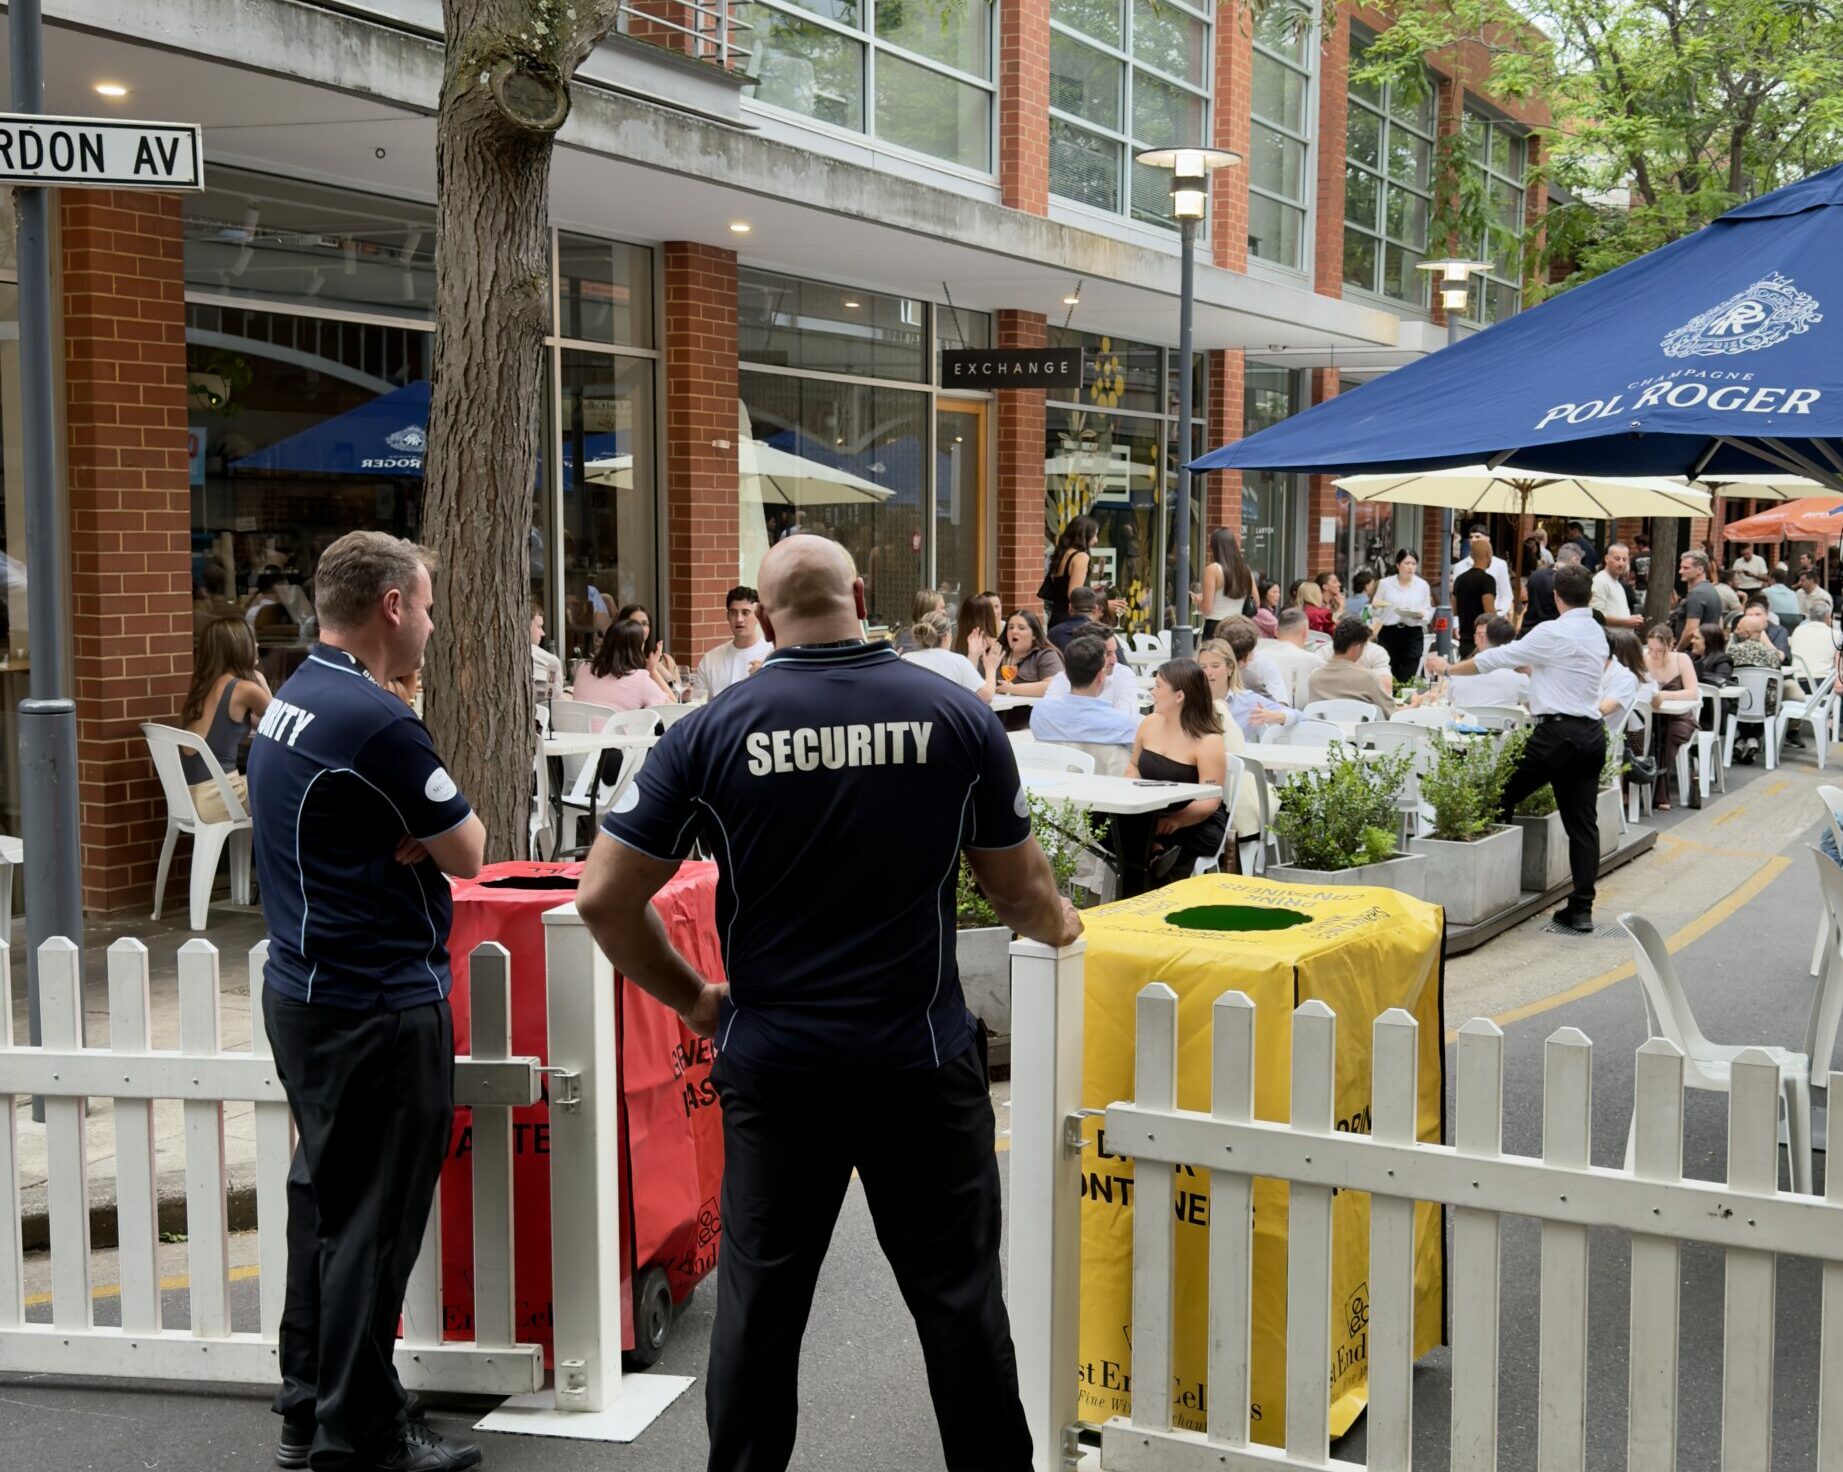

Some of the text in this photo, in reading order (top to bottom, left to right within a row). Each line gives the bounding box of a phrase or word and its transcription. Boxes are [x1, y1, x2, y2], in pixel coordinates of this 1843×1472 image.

[134, 136, 180, 176] AV
[954, 361, 1069, 375] EXCHANGE
[1627, 368, 1755, 390] CHAMPAGNE
[1534, 381, 1821, 430] POL ROGER
[746, 721, 934, 777] SECURITY
